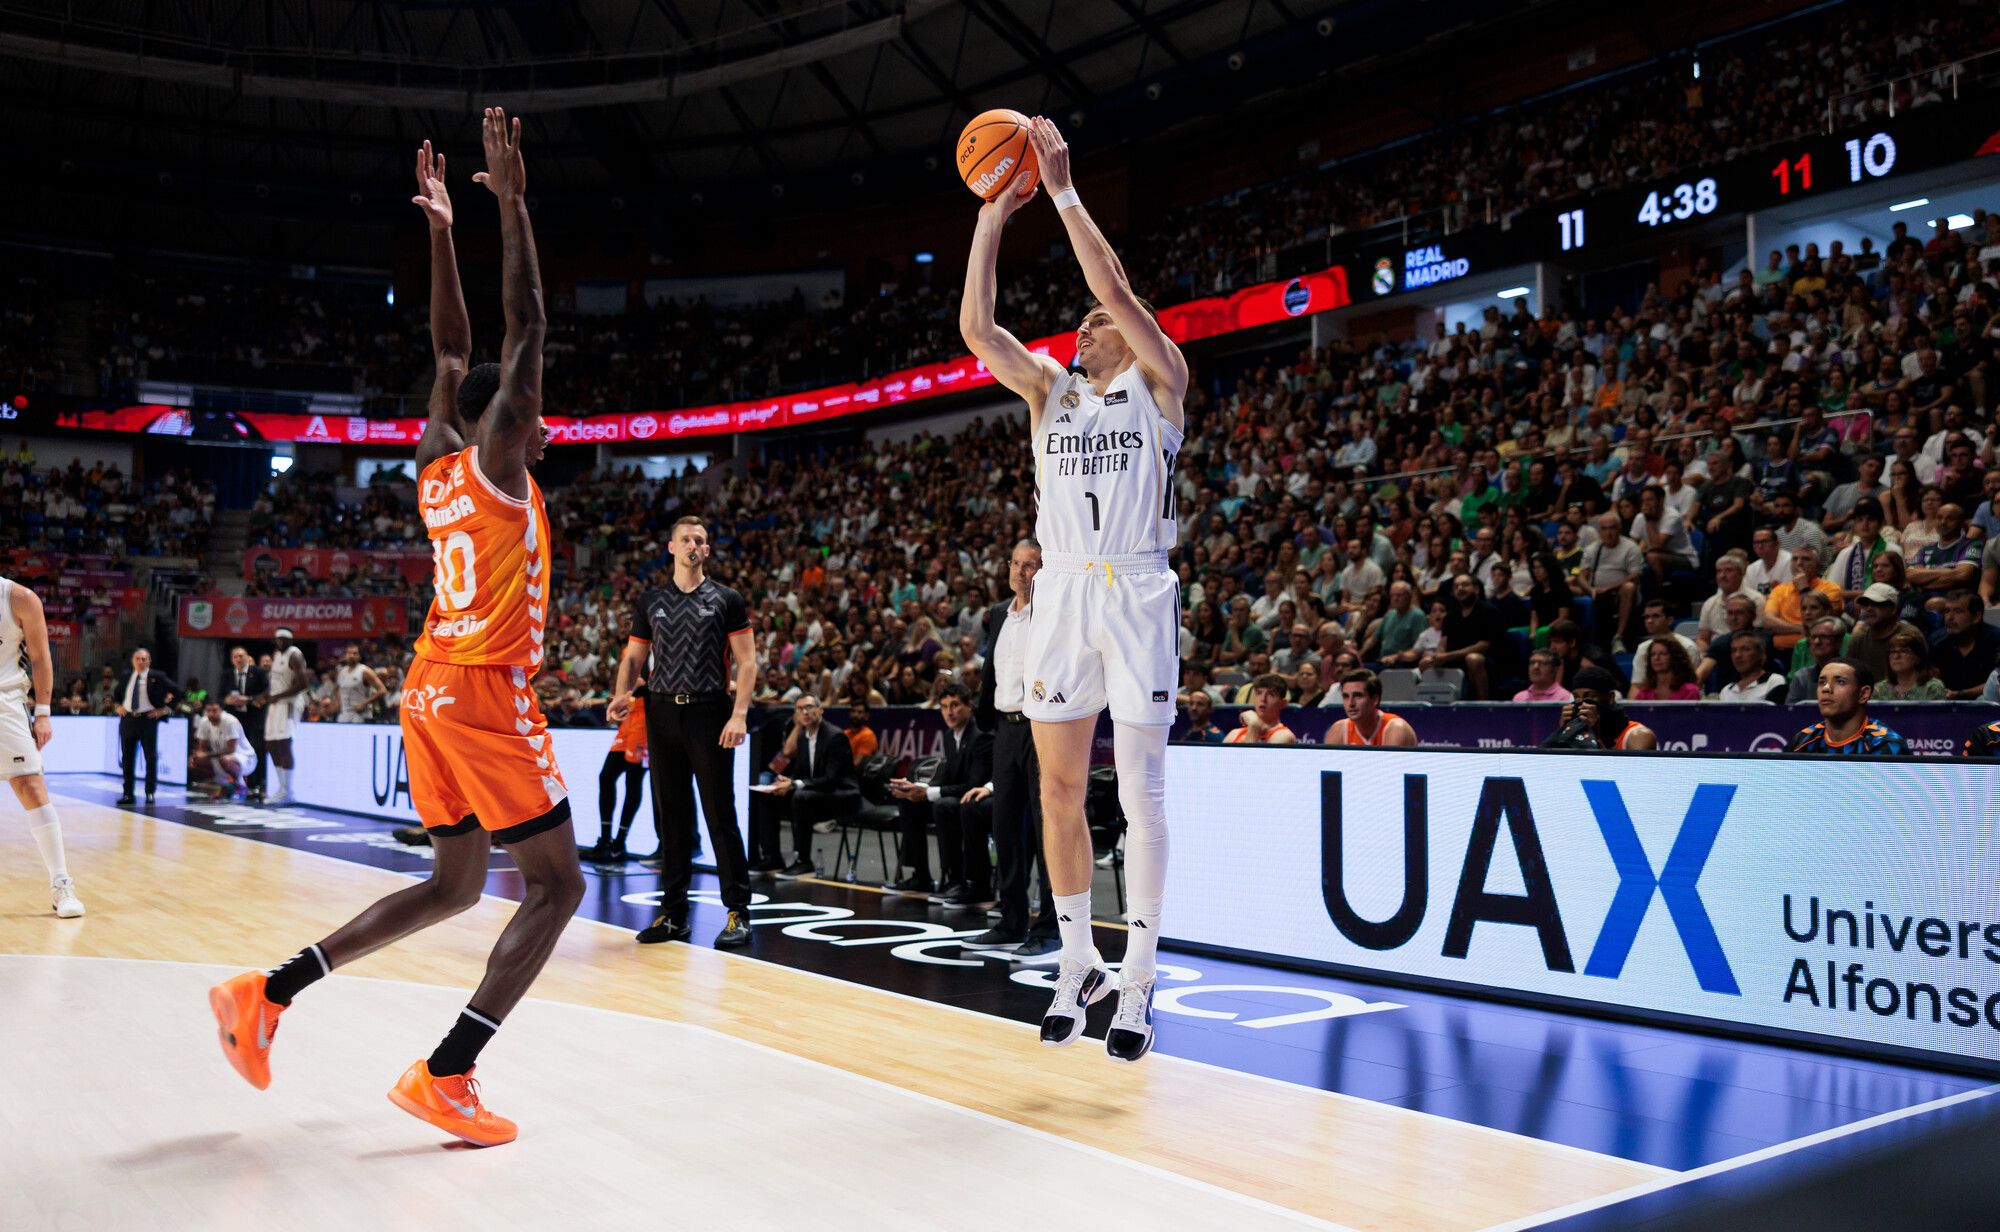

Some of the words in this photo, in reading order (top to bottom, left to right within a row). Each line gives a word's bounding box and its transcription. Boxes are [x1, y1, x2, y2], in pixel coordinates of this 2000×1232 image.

[960, 144, 975, 164] acb
[1772, 153, 1812, 194] 11
[1845, 132, 1896, 182] 10
[970, 155, 1015, 195] Wilson
[1638, 178, 1718, 227] 4:38
[1558, 209, 1584, 250] 11
[1405, 245, 1445, 268] REAL
[1405, 257, 1470, 289] MADRID
[1047, 430, 1144, 455] Emirates
[1058, 457, 1078, 476] FLY
[1082, 453, 1129, 475] BETTER
[1084, 491, 1100, 531] 1
[432, 531, 477, 612] 10
[263, 603, 352, 619] SUPERCOPA
[1906, 738, 1953, 750] BANCO
[1321, 770, 1742, 996] UAX
